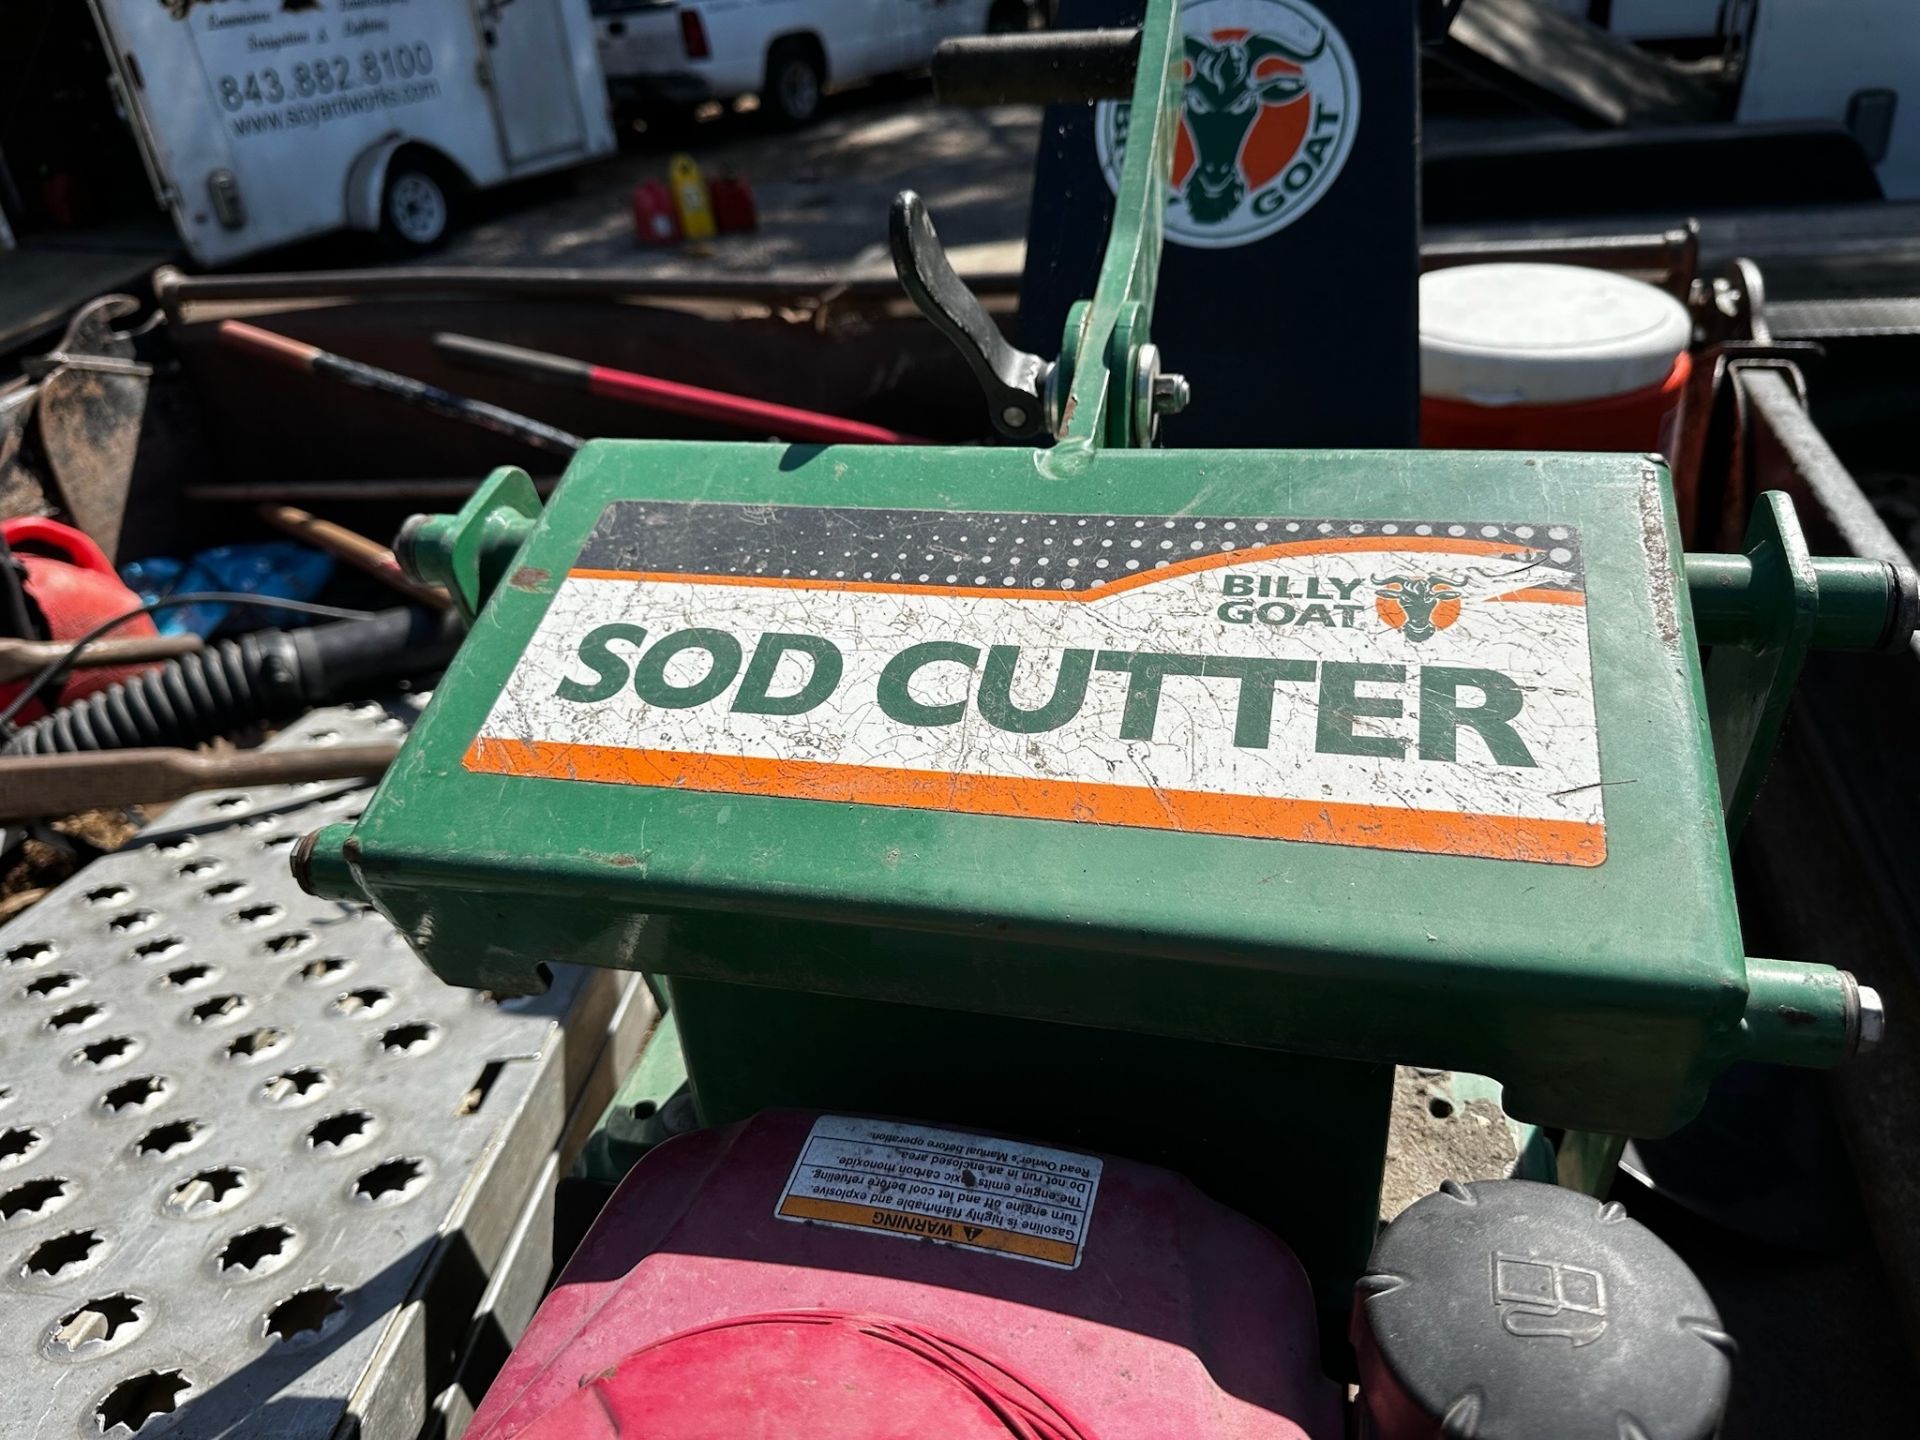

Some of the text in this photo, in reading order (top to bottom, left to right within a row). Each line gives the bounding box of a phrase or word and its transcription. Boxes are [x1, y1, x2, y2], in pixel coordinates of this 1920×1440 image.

[219, 42, 433, 112] 843.882.8100
[1253, 102, 1339, 217] GOAT
[1222, 574, 1364, 600] BILLY
[1216, 600, 1364, 628] GOAT
[556, 622, 1538, 768] SOD CUTTER
[869, 1132, 1089, 1177] Read Owner's Manual before operation.
[835, 1155, 896, 1172] monoxide.
[931, 1155, 984, 1172] enclosed
[986, 1165, 1003, 1175] an
[898, 1165, 940, 1180] carbon
[1007, 1168, 1018, 1179] in
[1021, 1171, 1042, 1182] run
[977, 1178, 1010, 1192] emits
[1044, 1176, 1065, 1188] not
[1068, 1180, 1086, 1192] Do
[810, 1168, 1077, 1224] Turn engine off and let cool before refueling.
[1013, 1184, 1056, 1201] engine
[1056, 1193, 1082, 1207] The
[809, 1182, 1075, 1240] Gasoline is highly flammable and explosive.
[871, 1210, 953, 1236] WARNING
